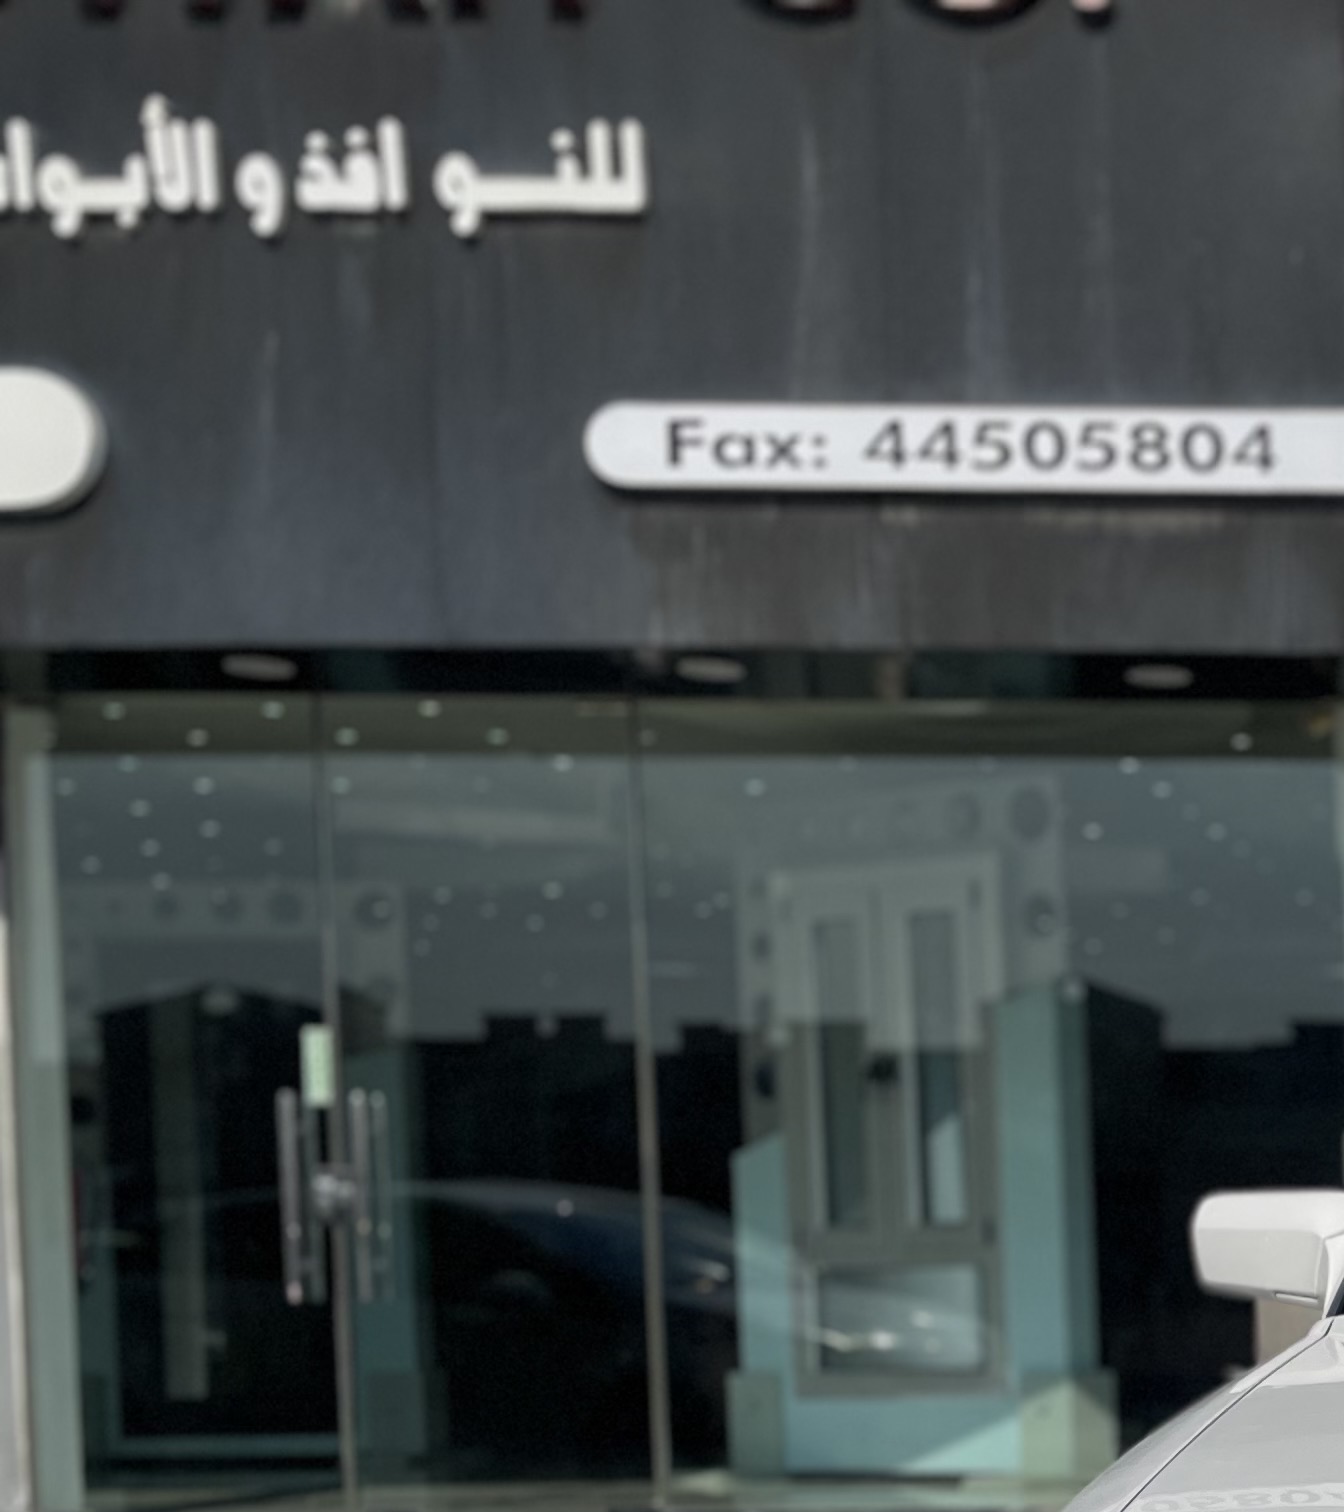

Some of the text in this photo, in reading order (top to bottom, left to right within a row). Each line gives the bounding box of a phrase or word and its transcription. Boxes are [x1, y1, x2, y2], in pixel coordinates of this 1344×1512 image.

[0, 93, 283, 238] والأبوا
[665, 418, 1278, 474] Fax: 44505804
